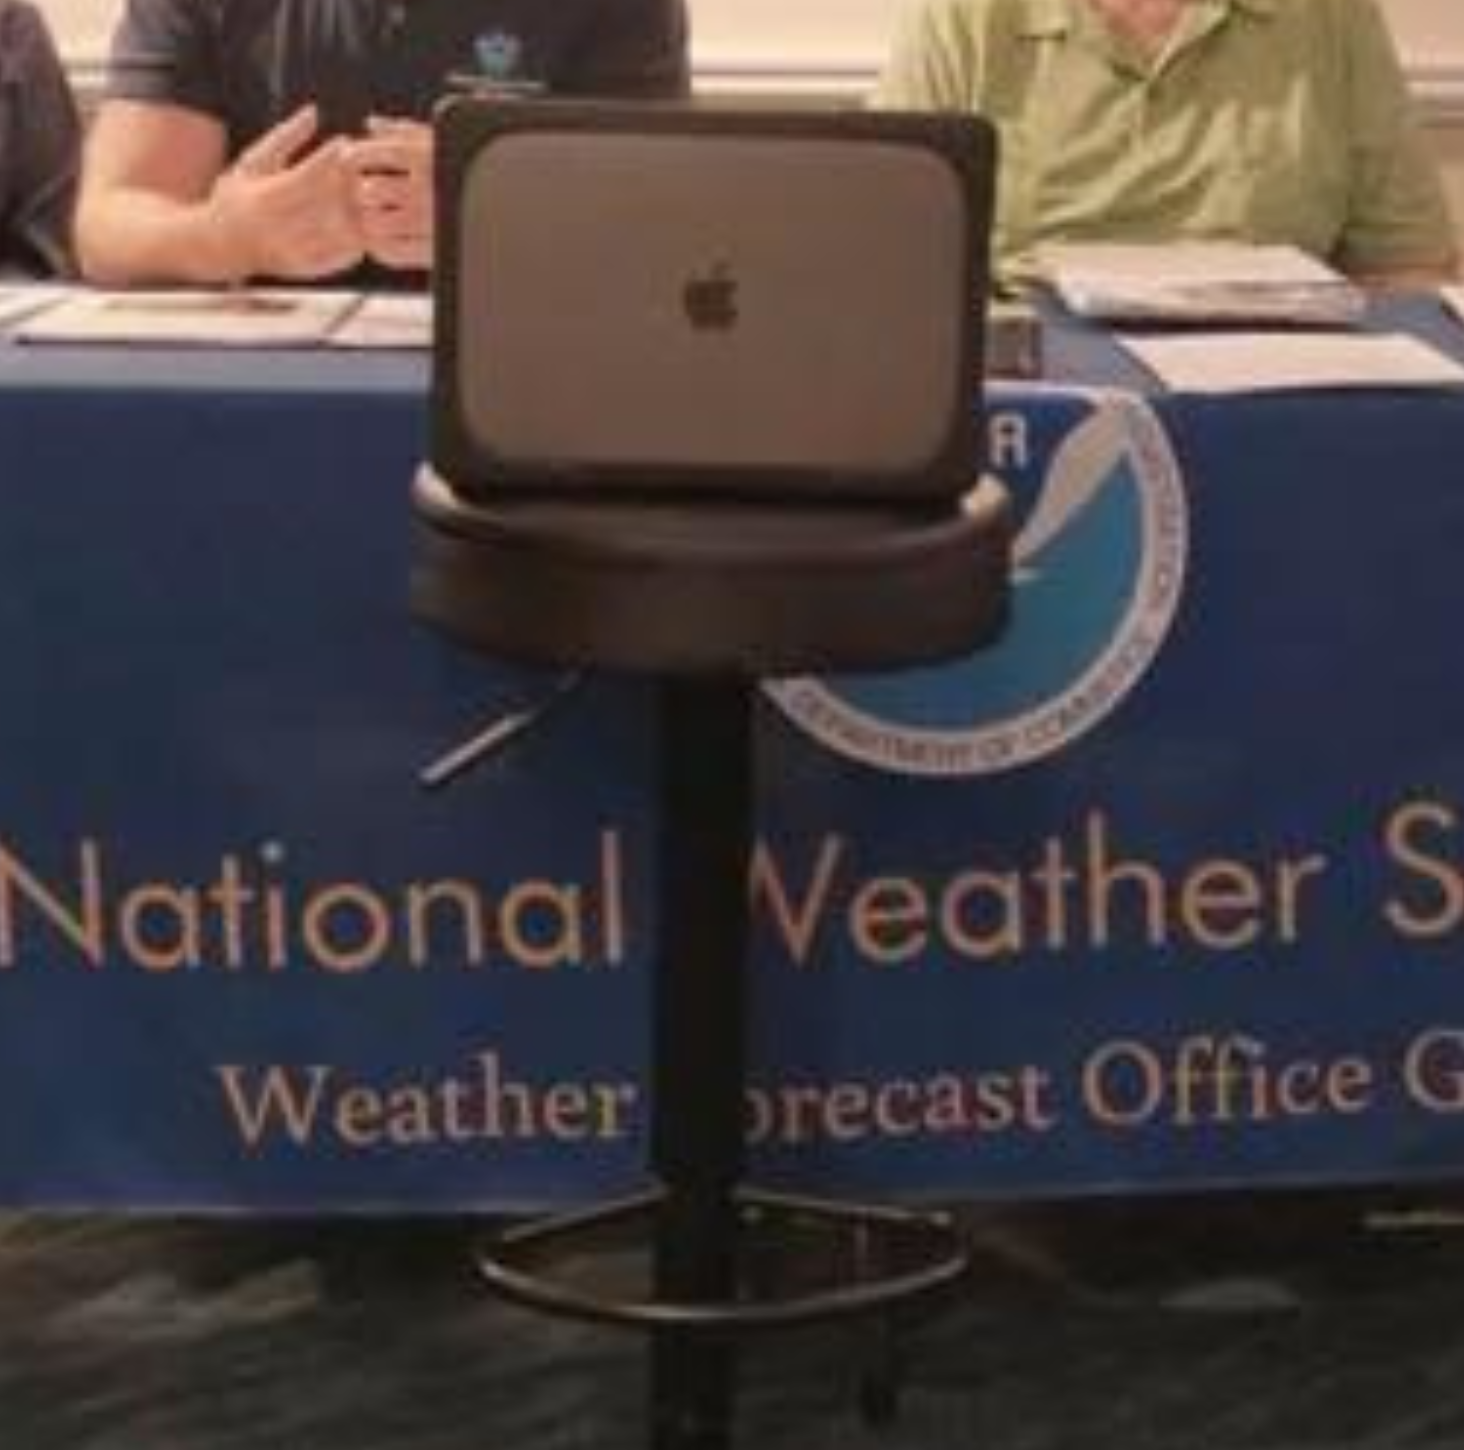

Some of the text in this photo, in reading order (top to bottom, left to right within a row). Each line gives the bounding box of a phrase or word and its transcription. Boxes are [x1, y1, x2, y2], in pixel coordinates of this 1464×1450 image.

[216, 1050, 637, 1147] Weather
[742, 1063, 1058, 1144] orecast
[1082, 1034, 1372, 1126] Office
